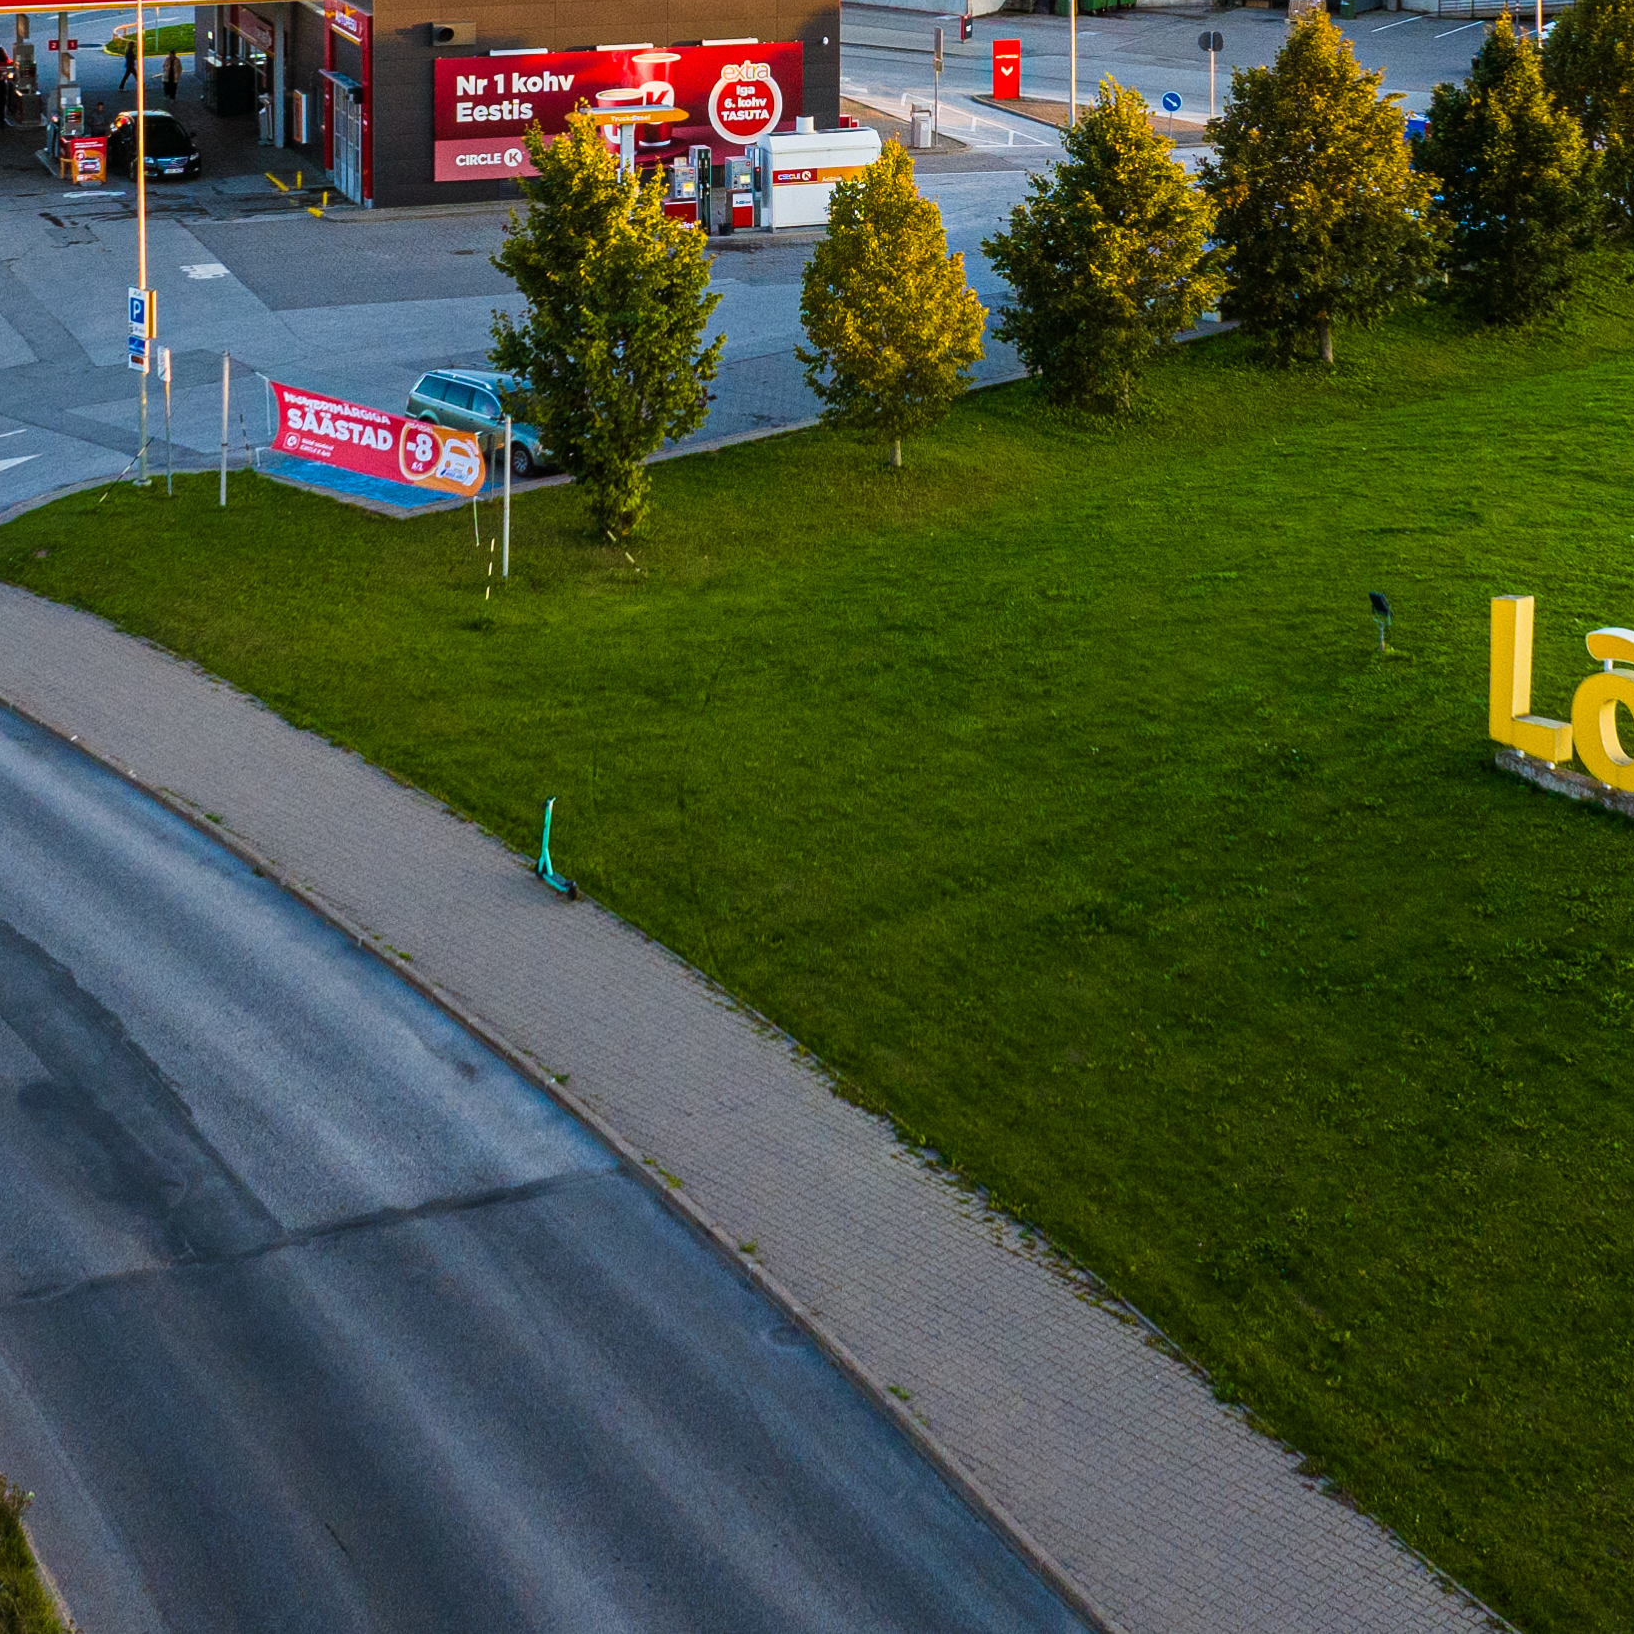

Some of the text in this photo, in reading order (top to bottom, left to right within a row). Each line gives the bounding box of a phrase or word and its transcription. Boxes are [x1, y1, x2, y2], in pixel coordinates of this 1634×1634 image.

[721, 62, 769, 80] extra
[456, 71, 575, 96] Nr 1 kohv
[736, 85, 755, 96] Iga
[456, 99, 534, 123] Eestis
[724, 97, 768, 109] 6. kohv
[721, 109, 770, 122] TASUTA
[455, 152, 502, 166] CIRCLE
[132, 300, 142, 320] P
[286, 407, 394, 451] SÄÄSTAD
[406, 433, 434, 462] -8
